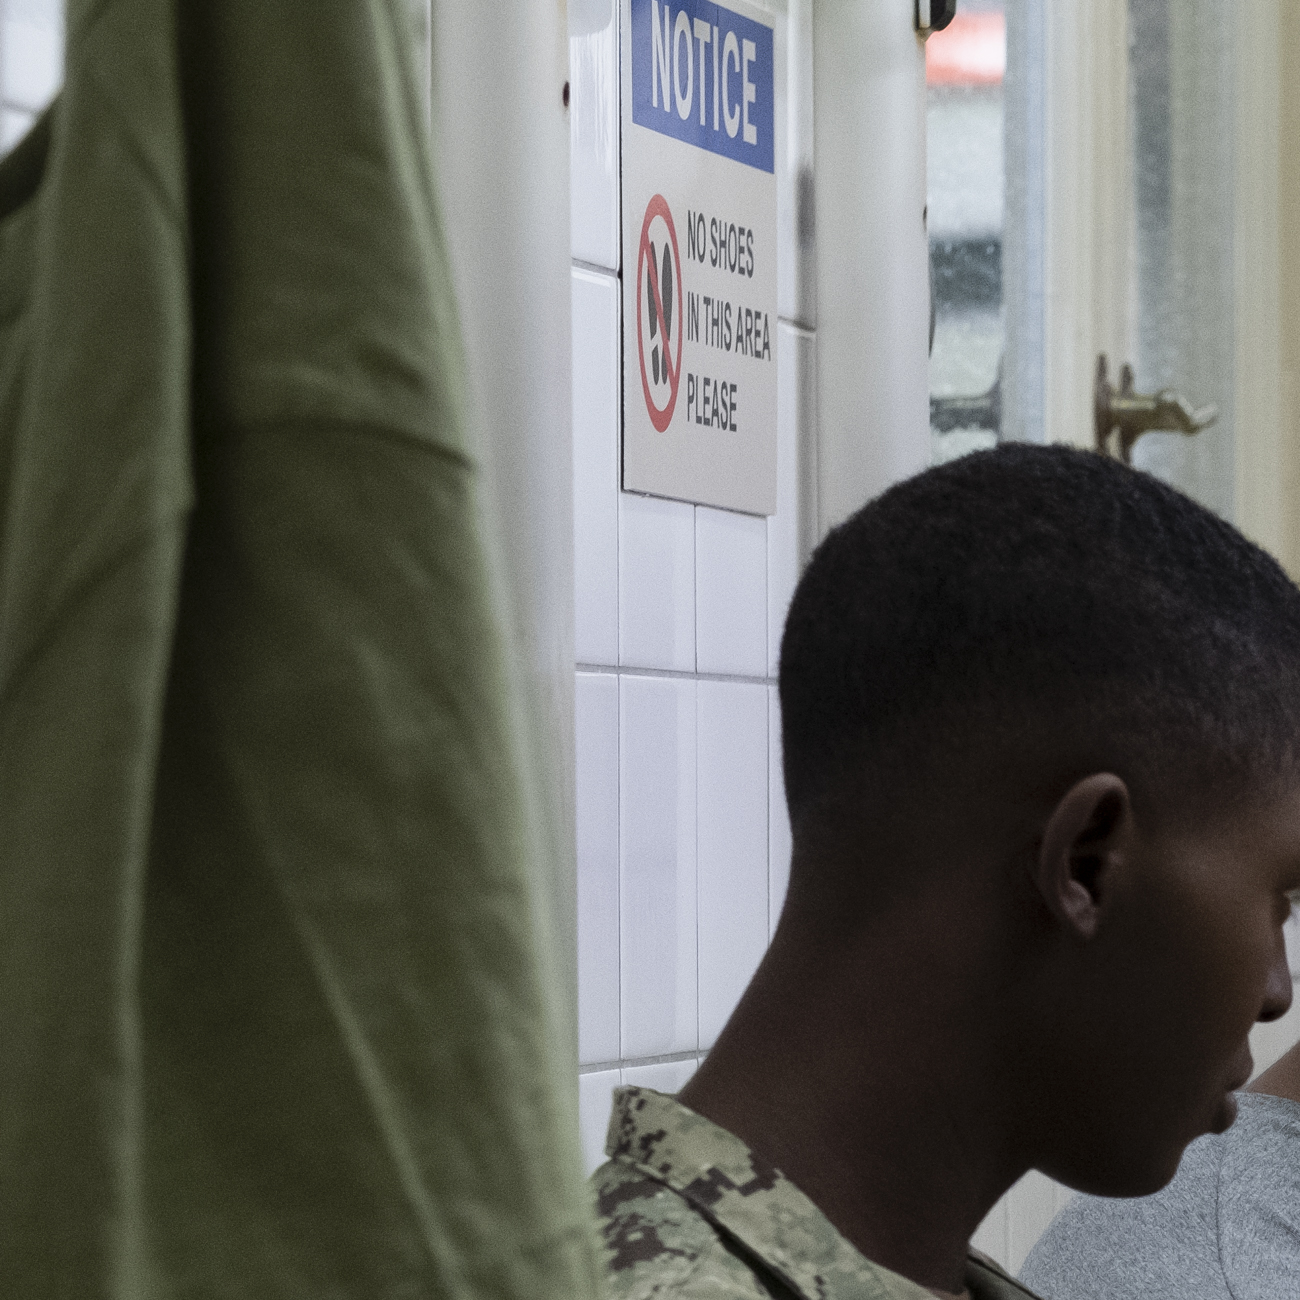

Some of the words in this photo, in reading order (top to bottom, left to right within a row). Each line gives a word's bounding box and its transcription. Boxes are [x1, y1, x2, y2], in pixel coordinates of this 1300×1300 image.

[651, 0, 757, 145] NOTICE
[687, 210, 706, 263] NO
[710, 217, 754, 278] SHOES
[687, 291, 700, 342] IN
[703, 299, 732, 352] THIS
[735, 310, 771, 361] AREA
[687, 372, 737, 432] PLEASE
